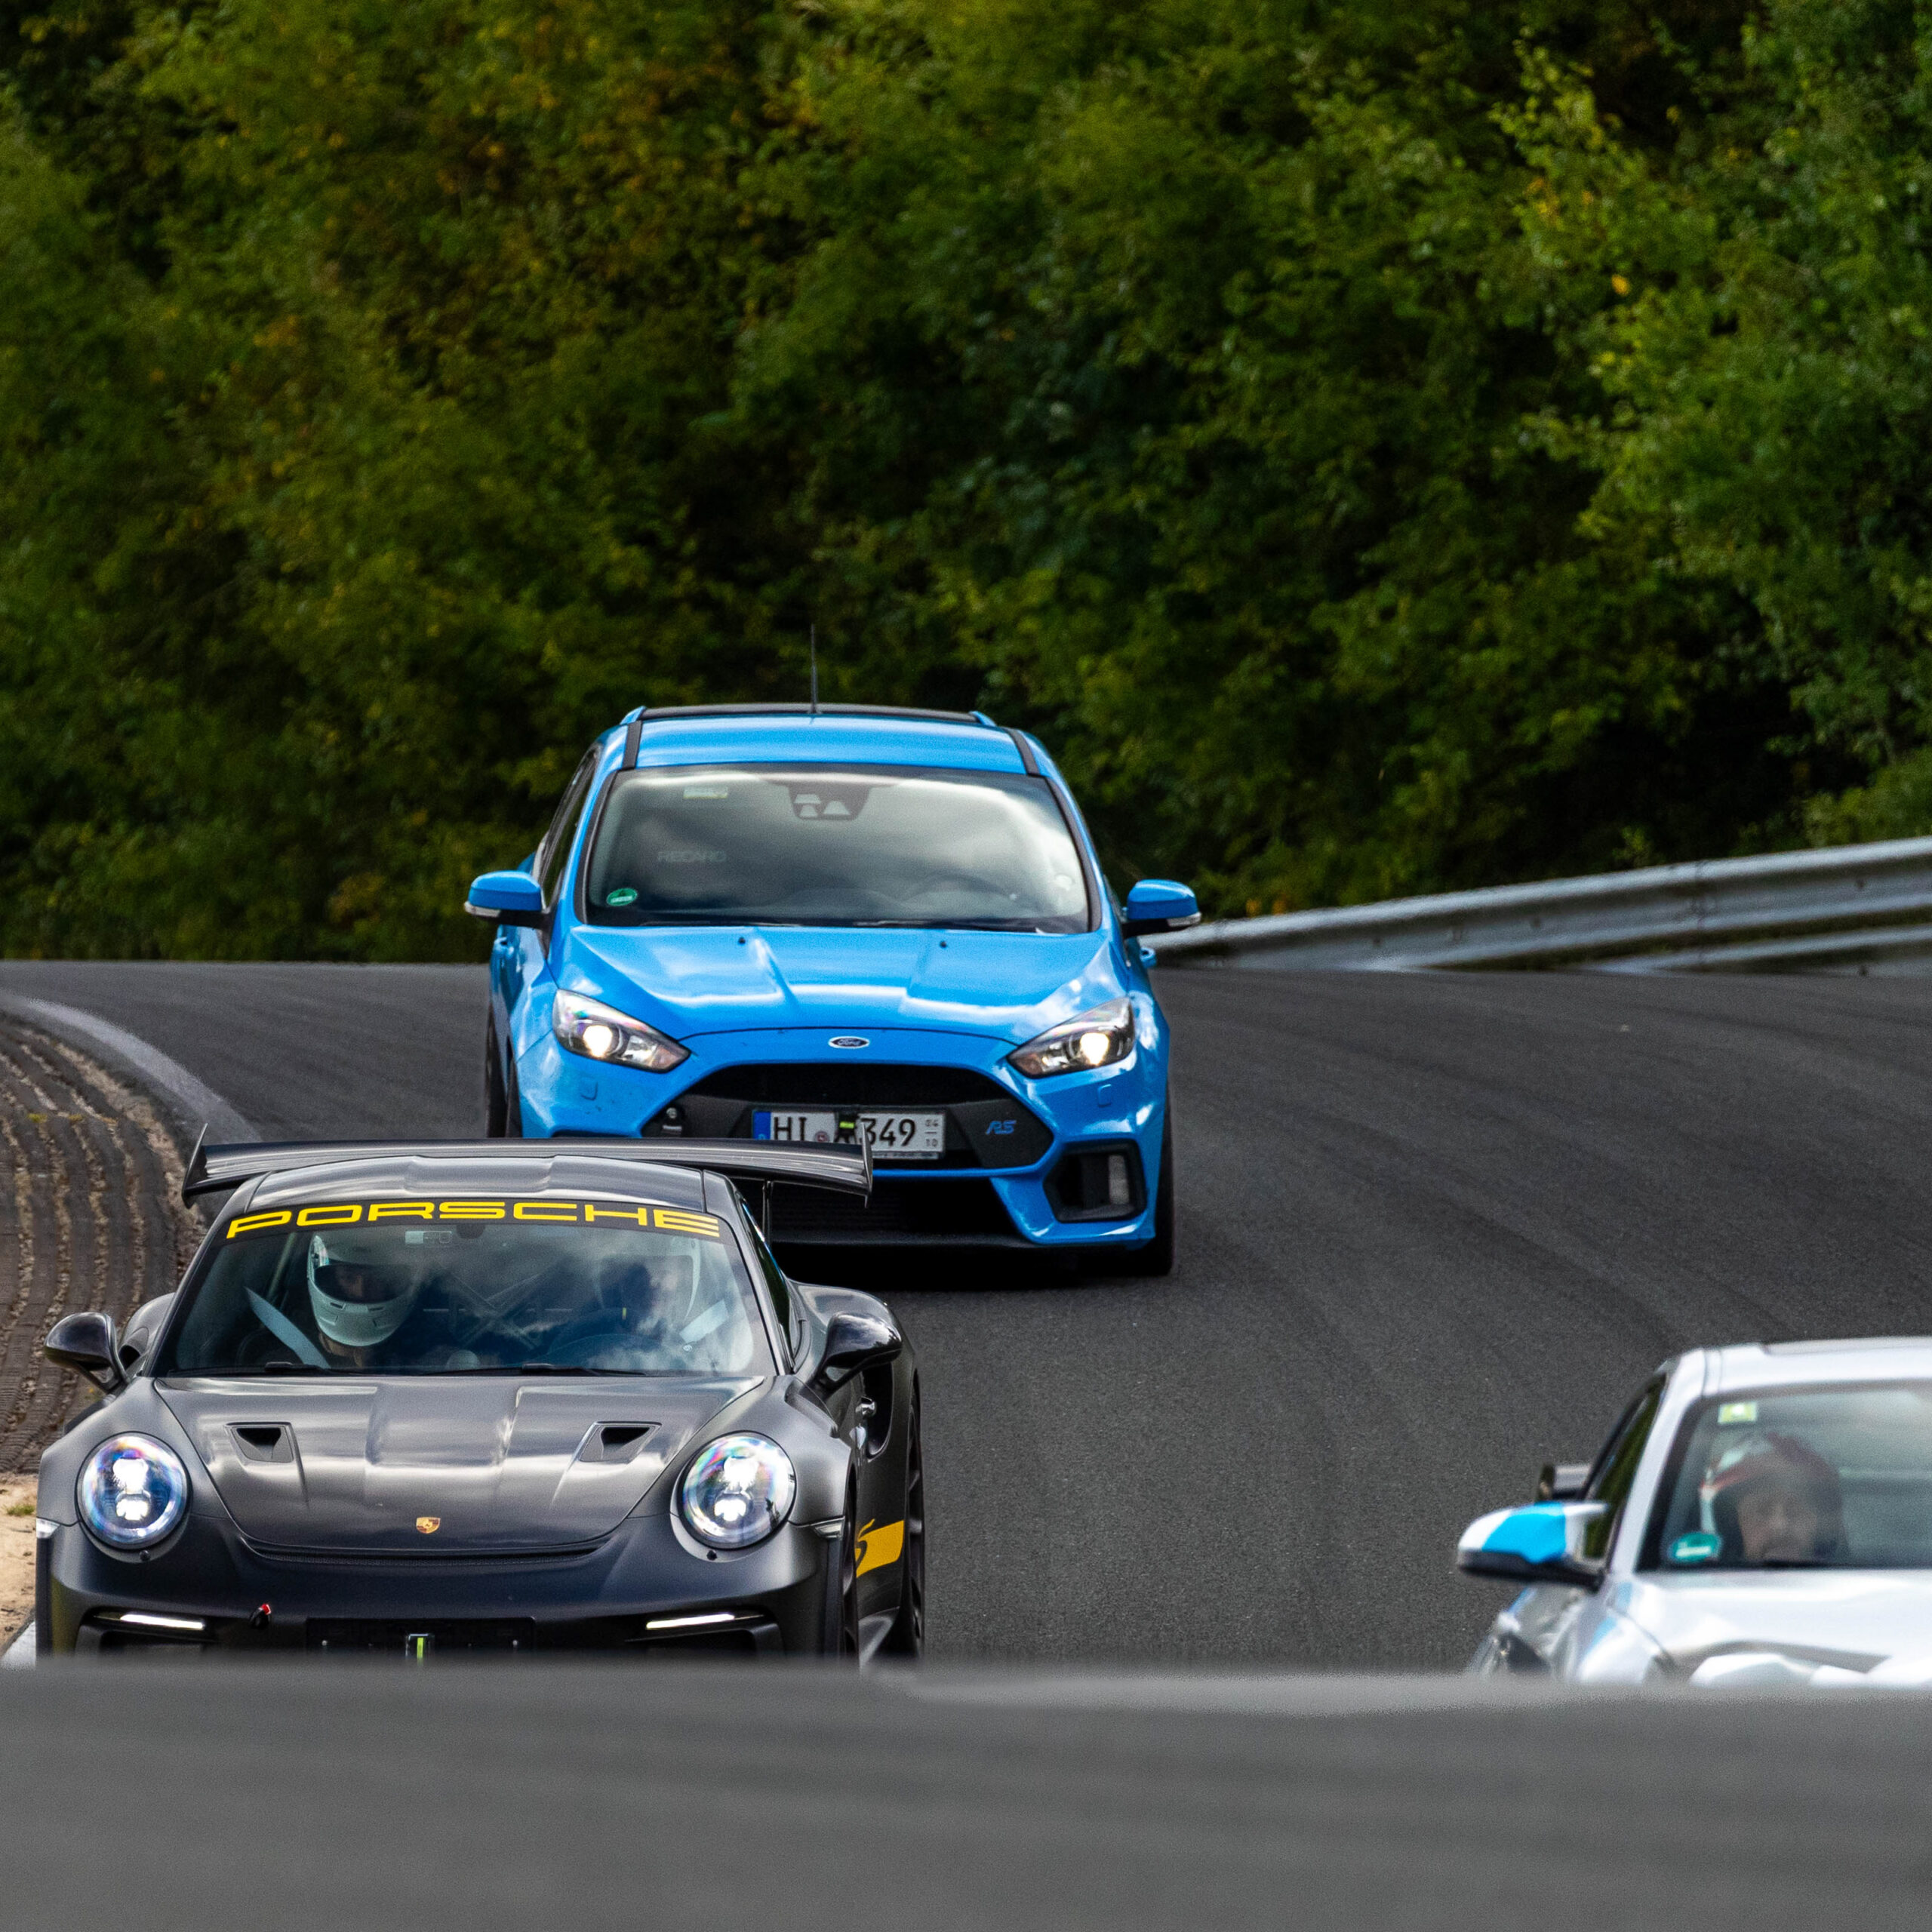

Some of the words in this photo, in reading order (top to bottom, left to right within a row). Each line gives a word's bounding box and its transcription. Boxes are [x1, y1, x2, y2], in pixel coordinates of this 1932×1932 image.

[774, 1116, 807, 1141] HI
[859, 1117, 917, 1147] 349
[985, 1119, 1017, 1135] RS
[226, 1201, 720, 1238] PORSCHE
